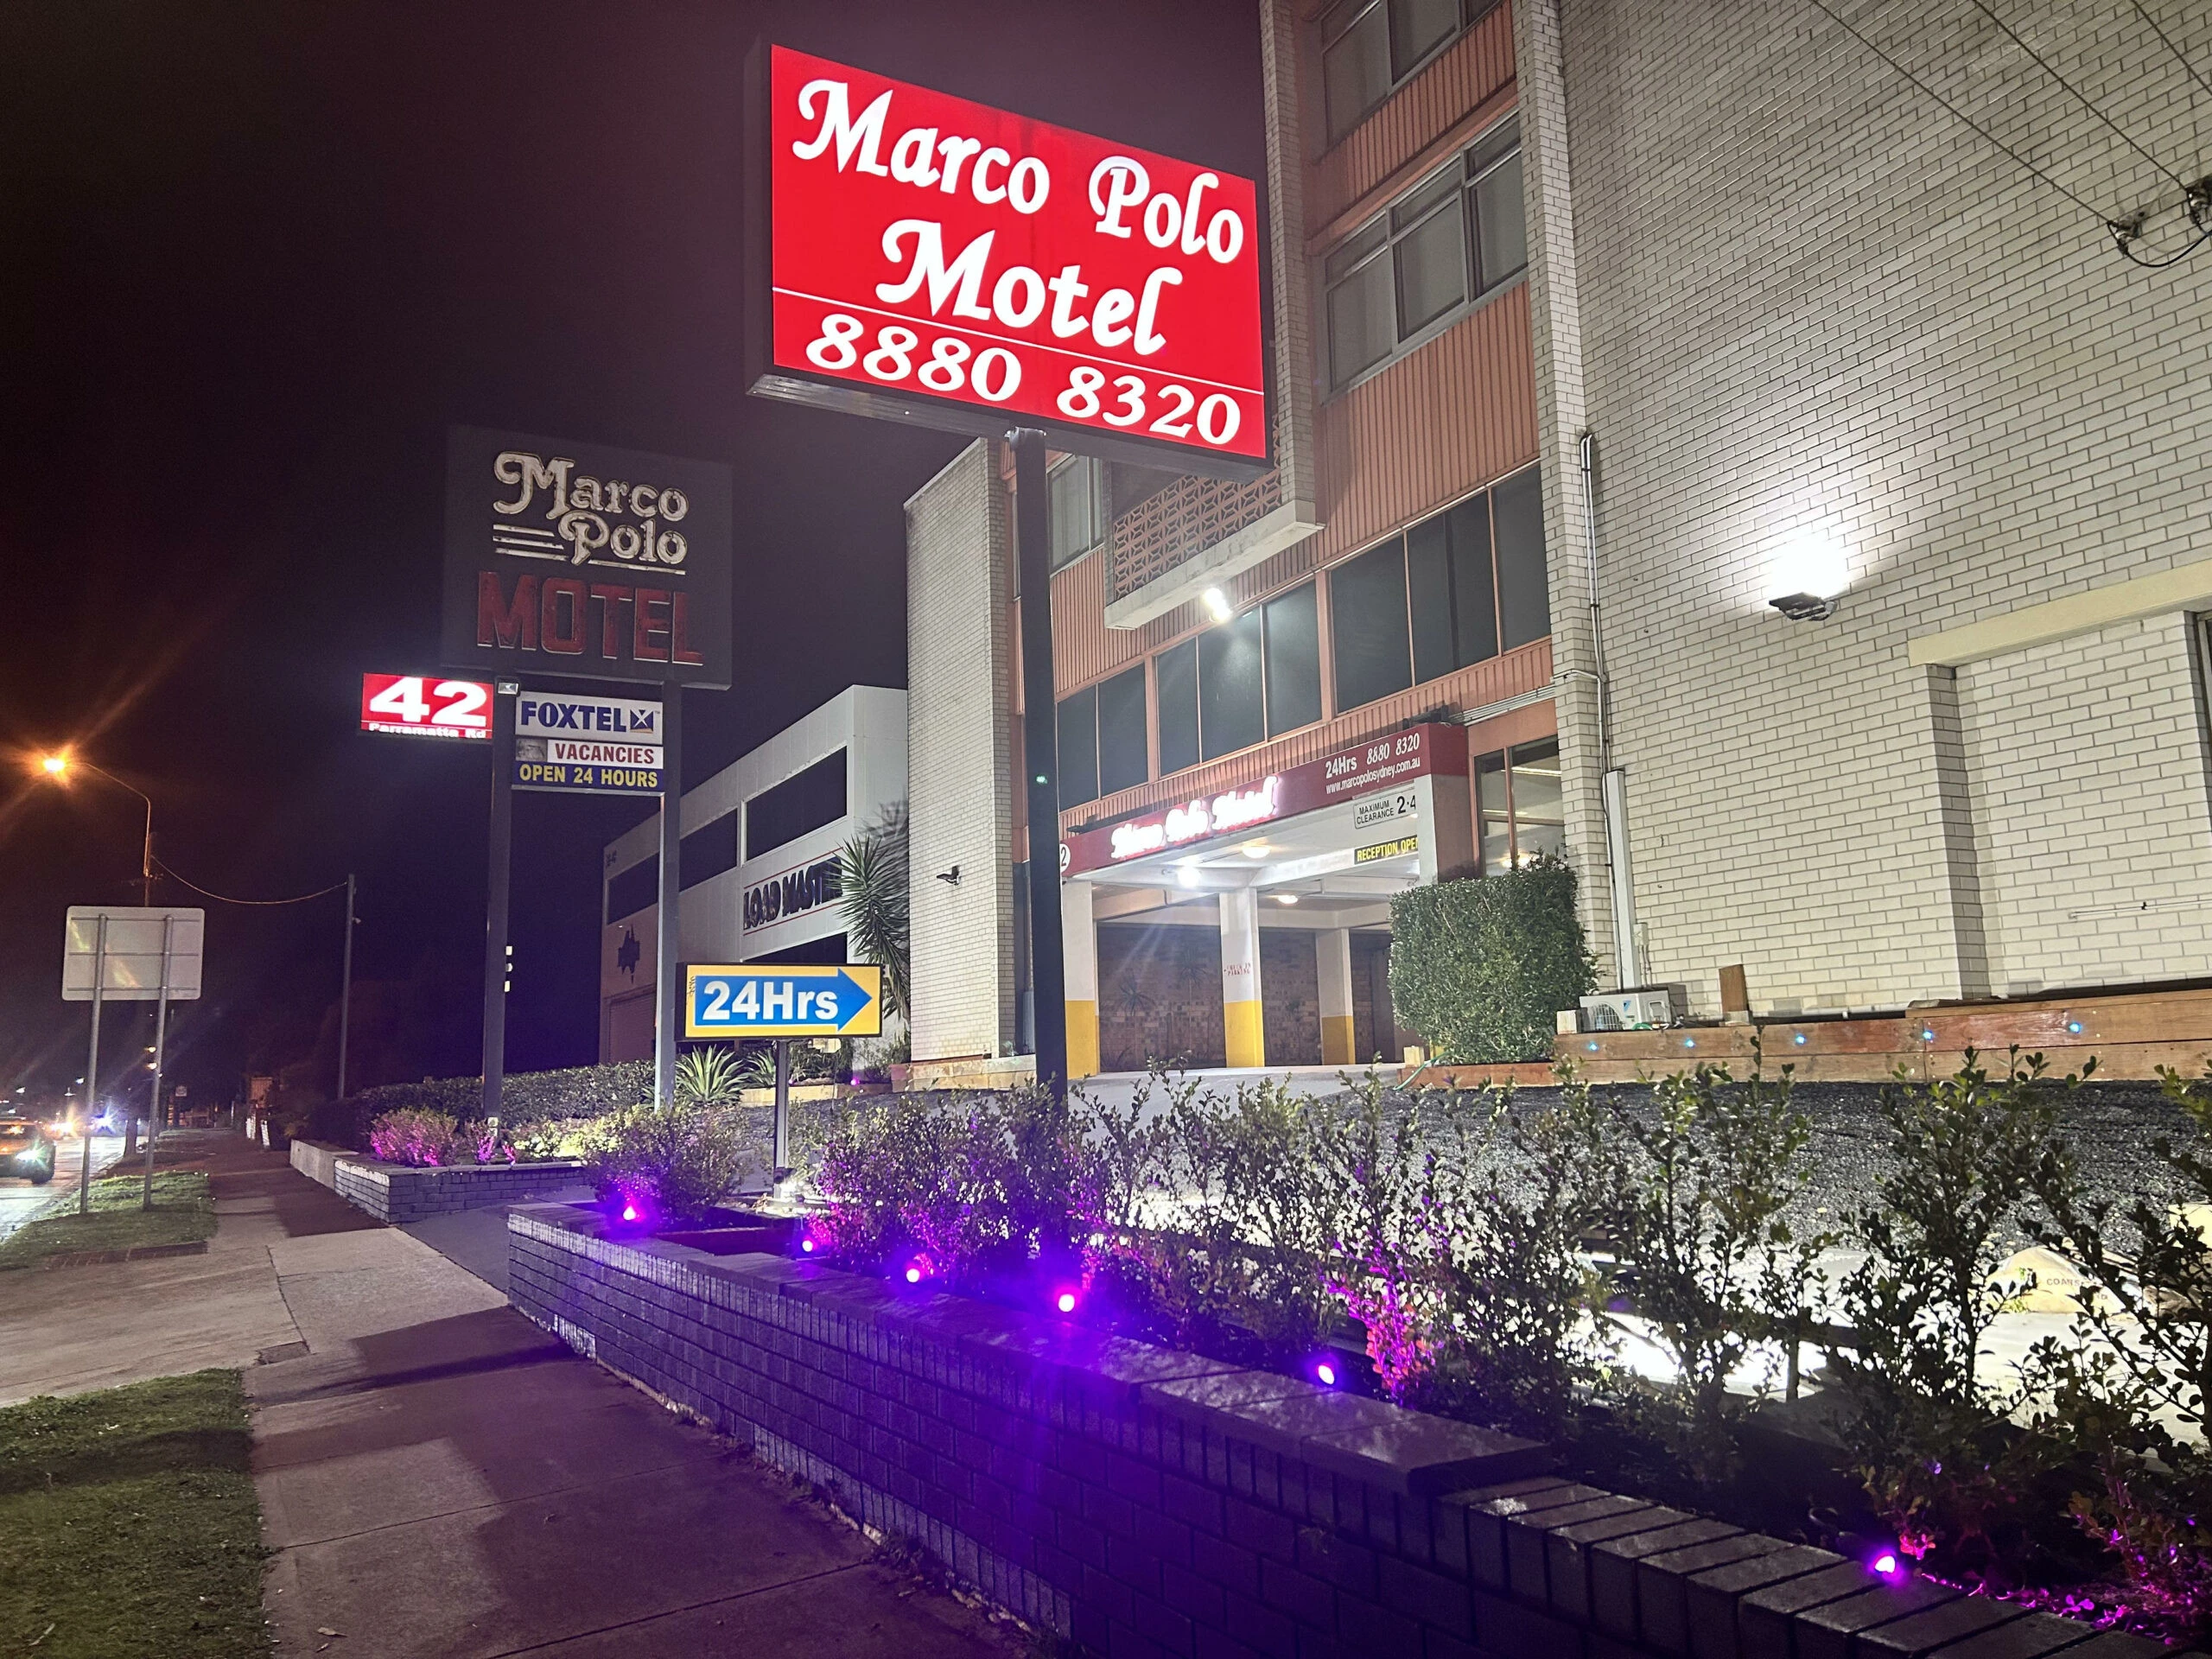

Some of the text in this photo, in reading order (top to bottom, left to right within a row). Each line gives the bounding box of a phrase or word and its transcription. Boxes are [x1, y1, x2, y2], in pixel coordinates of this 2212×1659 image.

[792, 79, 1243, 264] Marco Polo
[875, 219, 1183, 356] Motel
[805, 314, 1240, 445] 8880 8320
[493, 452, 689, 521] Marco
[558, 510, 688, 565] Polo
[478, 571, 703, 665] MOTEL
[370, 677, 486, 727] 42
[521, 701, 626, 732] FOXTEL
[555, 743, 654, 764] VACANCIES
[1325, 733, 1419, 779] 24Hrs 8880 8320
[519, 764, 658, 787] OPEN 24 HOURS
[1326, 757, 1421, 794] www.marcopolosydney.com.au
[1357, 808, 1395, 824] CLEARANCE
[1359, 800, 1389, 815] MAXIMUM
[1357, 842, 1398, 861] RECEPTION
[702, 981, 838, 1020] 24Hrs
